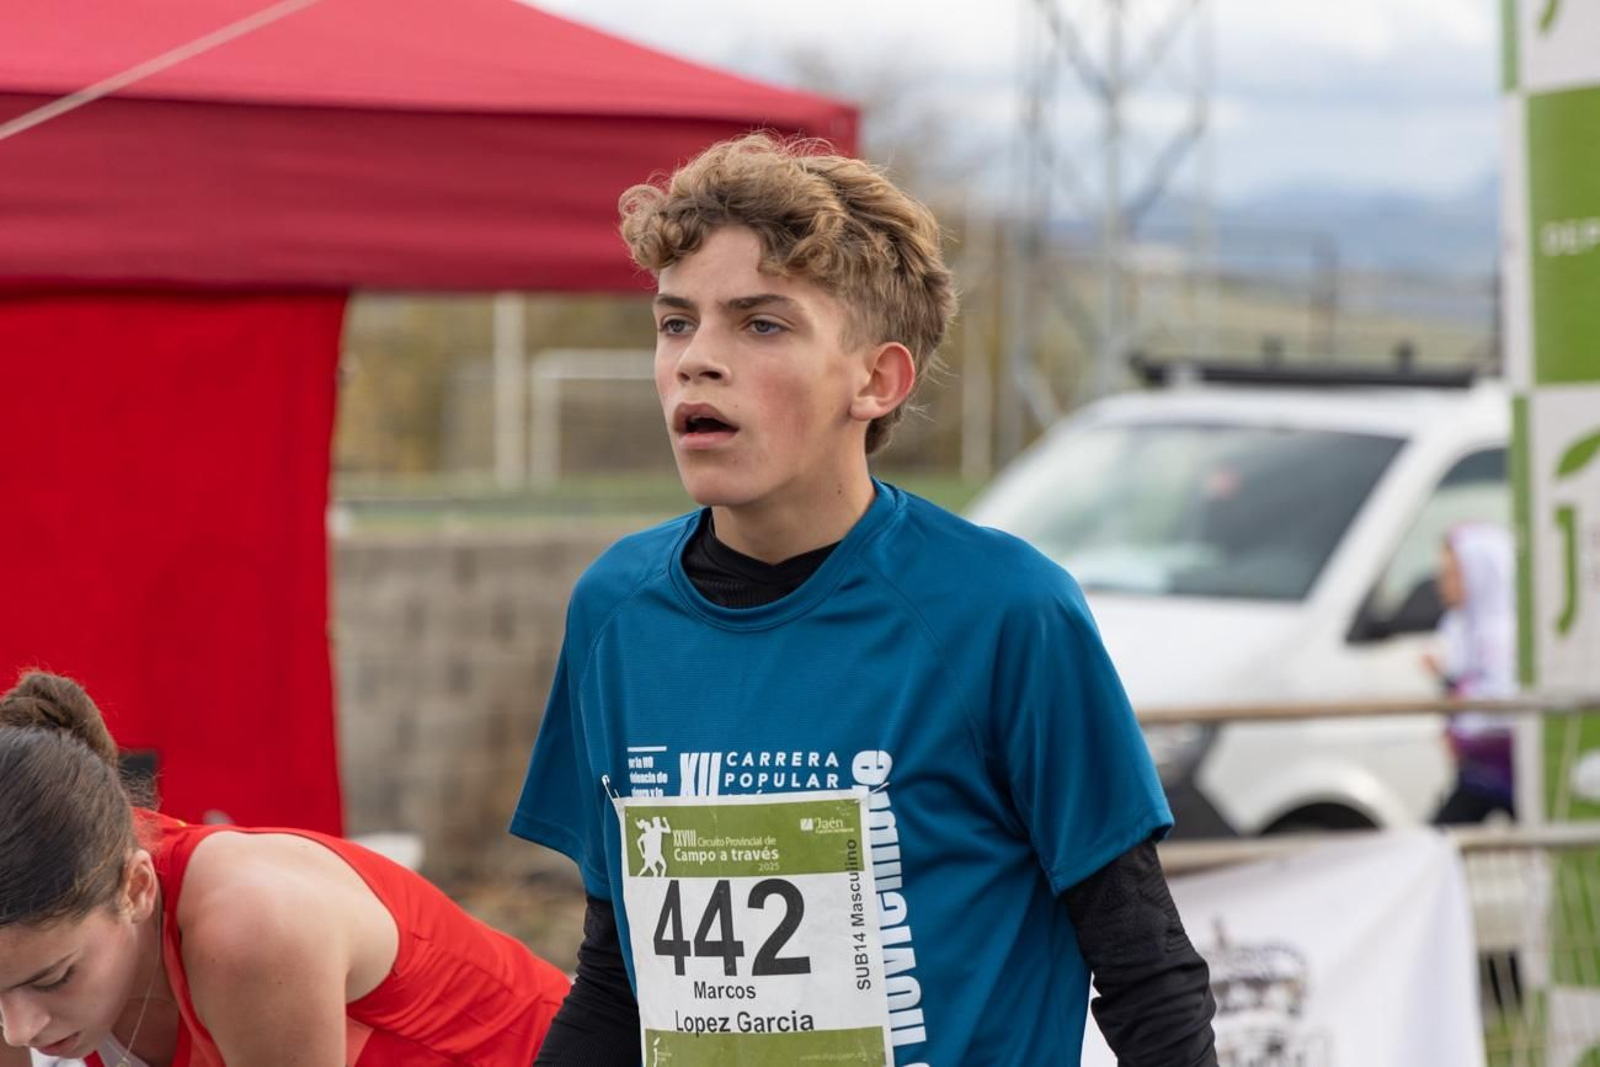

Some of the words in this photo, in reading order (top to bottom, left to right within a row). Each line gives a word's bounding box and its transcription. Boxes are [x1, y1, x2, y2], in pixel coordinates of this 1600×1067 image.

[726, 751, 839, 768] CARRERA
[680, 752, 721, 796] XII
[724, 773, 839, 789] POPULAR
[813, 816, 844, 829] Jaén
[673, 830, 696, 847] XXVIII
[698, 837, 724, 847] Circuito
[725, 835, 763, 847] Provincial
[764, 835, 777, 846] de
[674, 848, 716, 864] Campo
[720, 851, 728, 861] a
[731, 847, 779, 861] través
[758, 863, 780, 872] 2025
[845, 839, 865, 927] Masculino
[653, 878, 811, 977] 442
[853, 932, 871, 990] SUB14
[693, 981, 756, 999] Marcos
[675, 1010, 731, 1038] Lopez
[736, 1010, 814, 1033] Garcia
